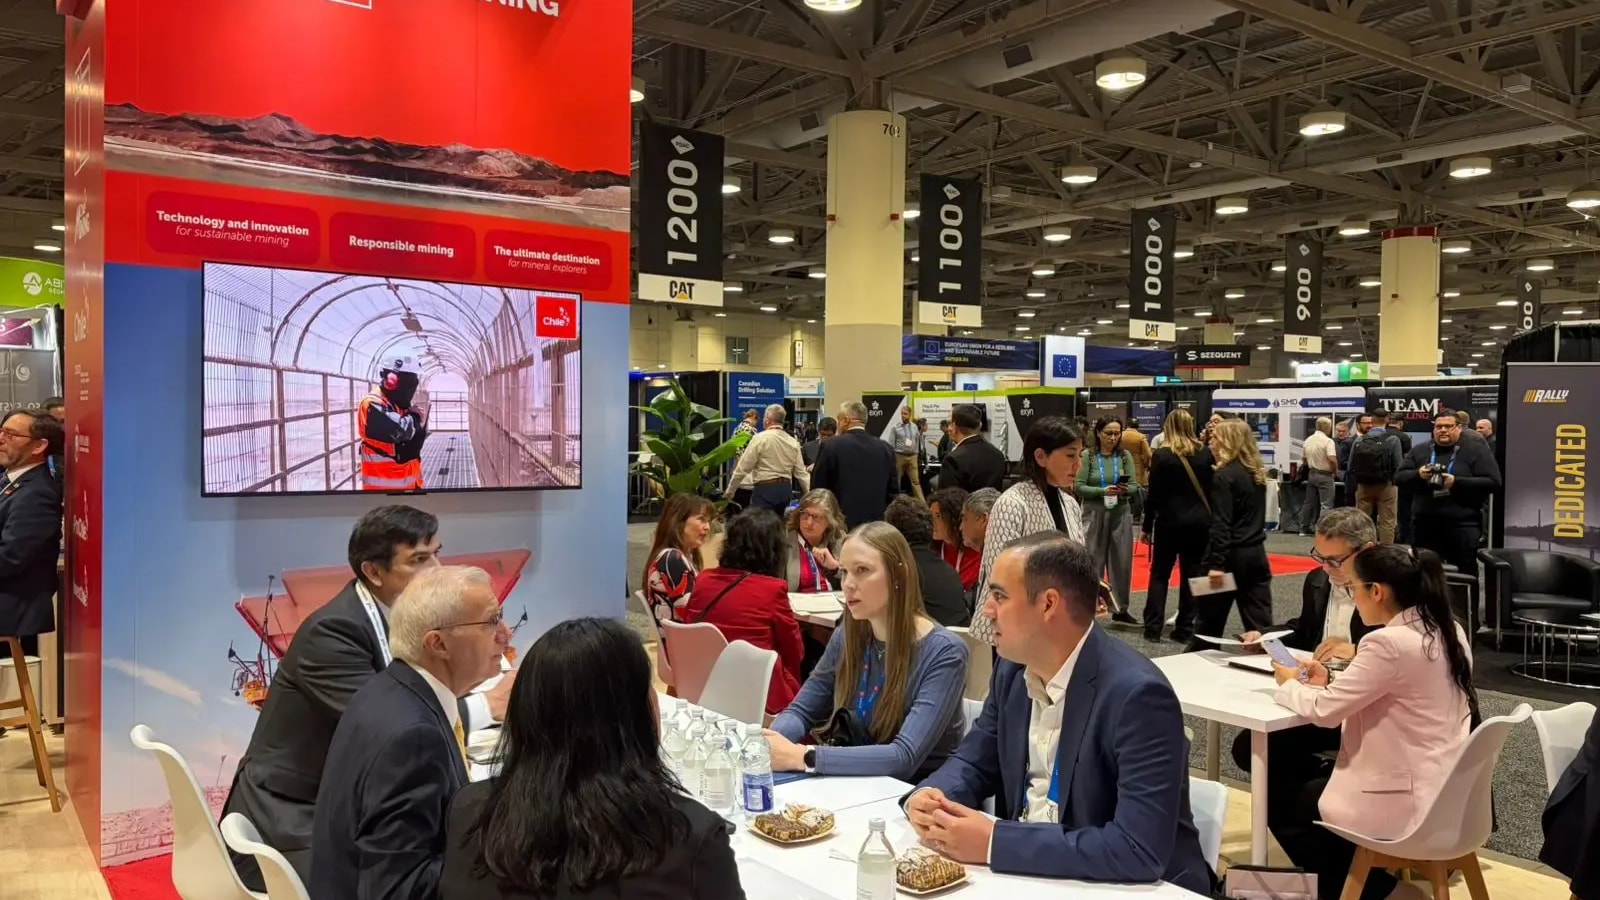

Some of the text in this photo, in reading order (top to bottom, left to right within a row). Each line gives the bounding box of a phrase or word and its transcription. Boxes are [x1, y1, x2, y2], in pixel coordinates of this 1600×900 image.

[667, 159, 698, 265] 1200
[156, 210, 310, 236] Technology and innovation
[175, 225, 290, 248] for sustainable mining
[349, 235, 454, 258] Responsible mining
[493, 245, 600, 265] The ultimate destination
[939, 204, 963, 294] 1100
[508, 258, 588, 275] for mineral explorers
[1144, 235, 1162, 312] 1000
[669, 280, 694, 300] CAT
[1296, 267, 1311, 321] 900
[542, 316, 565, 327] Chile
[942, 305, 958, 318] CAT
[1523, 301, 1533, 330] 00
[1145, 323, 1159, 337] CAT
[1200, 351, 1242, 359] SEEQUENT
[1534, 389, 1570, 403] RALLY
[1379, 398, 1440, 418] TEAM
[1554, 424, 1586, 538] DEDICATED
